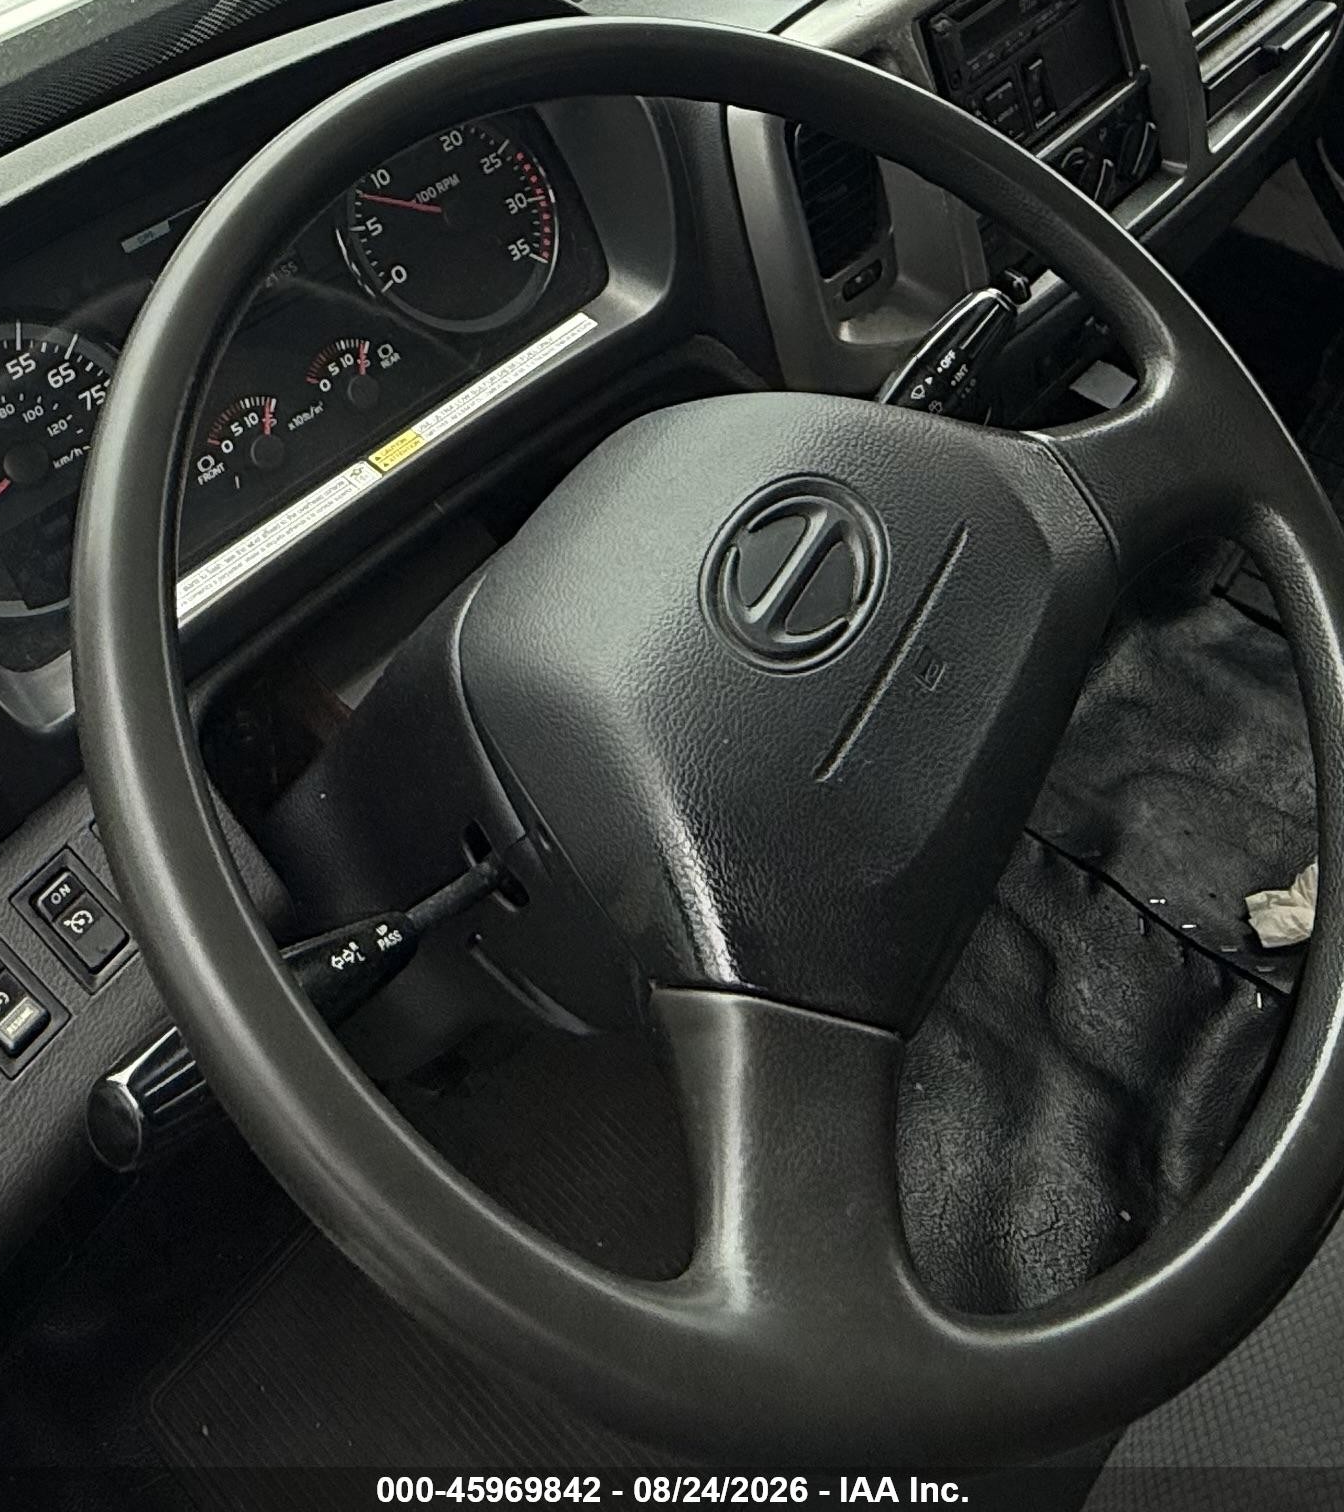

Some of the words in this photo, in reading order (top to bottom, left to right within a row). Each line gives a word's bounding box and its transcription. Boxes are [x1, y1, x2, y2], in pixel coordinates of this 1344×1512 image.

[440, 130, 463, 152] 20
[480, 153, 502, 175] 25
[370, 168, 391, 189] 10
[436, 173, 461, 194] RPM
[506, 193, 527, 214] 30
[366, 217, 383, 236] 5
[508, 239, 530, 261] 35
[391, 265, 407, 283] 0
[6, 352, 36, 380] 55
[340, 353, 354, 368] 10
[940, 349, 956, 368] OFF
[47, 362, 76, 389] 65
[328, 363, 339, 376] 5
[319, 379, 331, 392] 0
[78, 384, 106, 411] 75
[22, 405, 44, 423] 100
[244, 412, 259, 428] 10
[46, 419, 68, 437] 120
[230, 421, 244, 437] 5
[220, 440, 234, 454] 0
[53, 447, 83, 469] km/h
[197, 462, 226, 486] FRONT
[50, 884, 71, 905] ON
[377, 929, 403, 951] PASS
